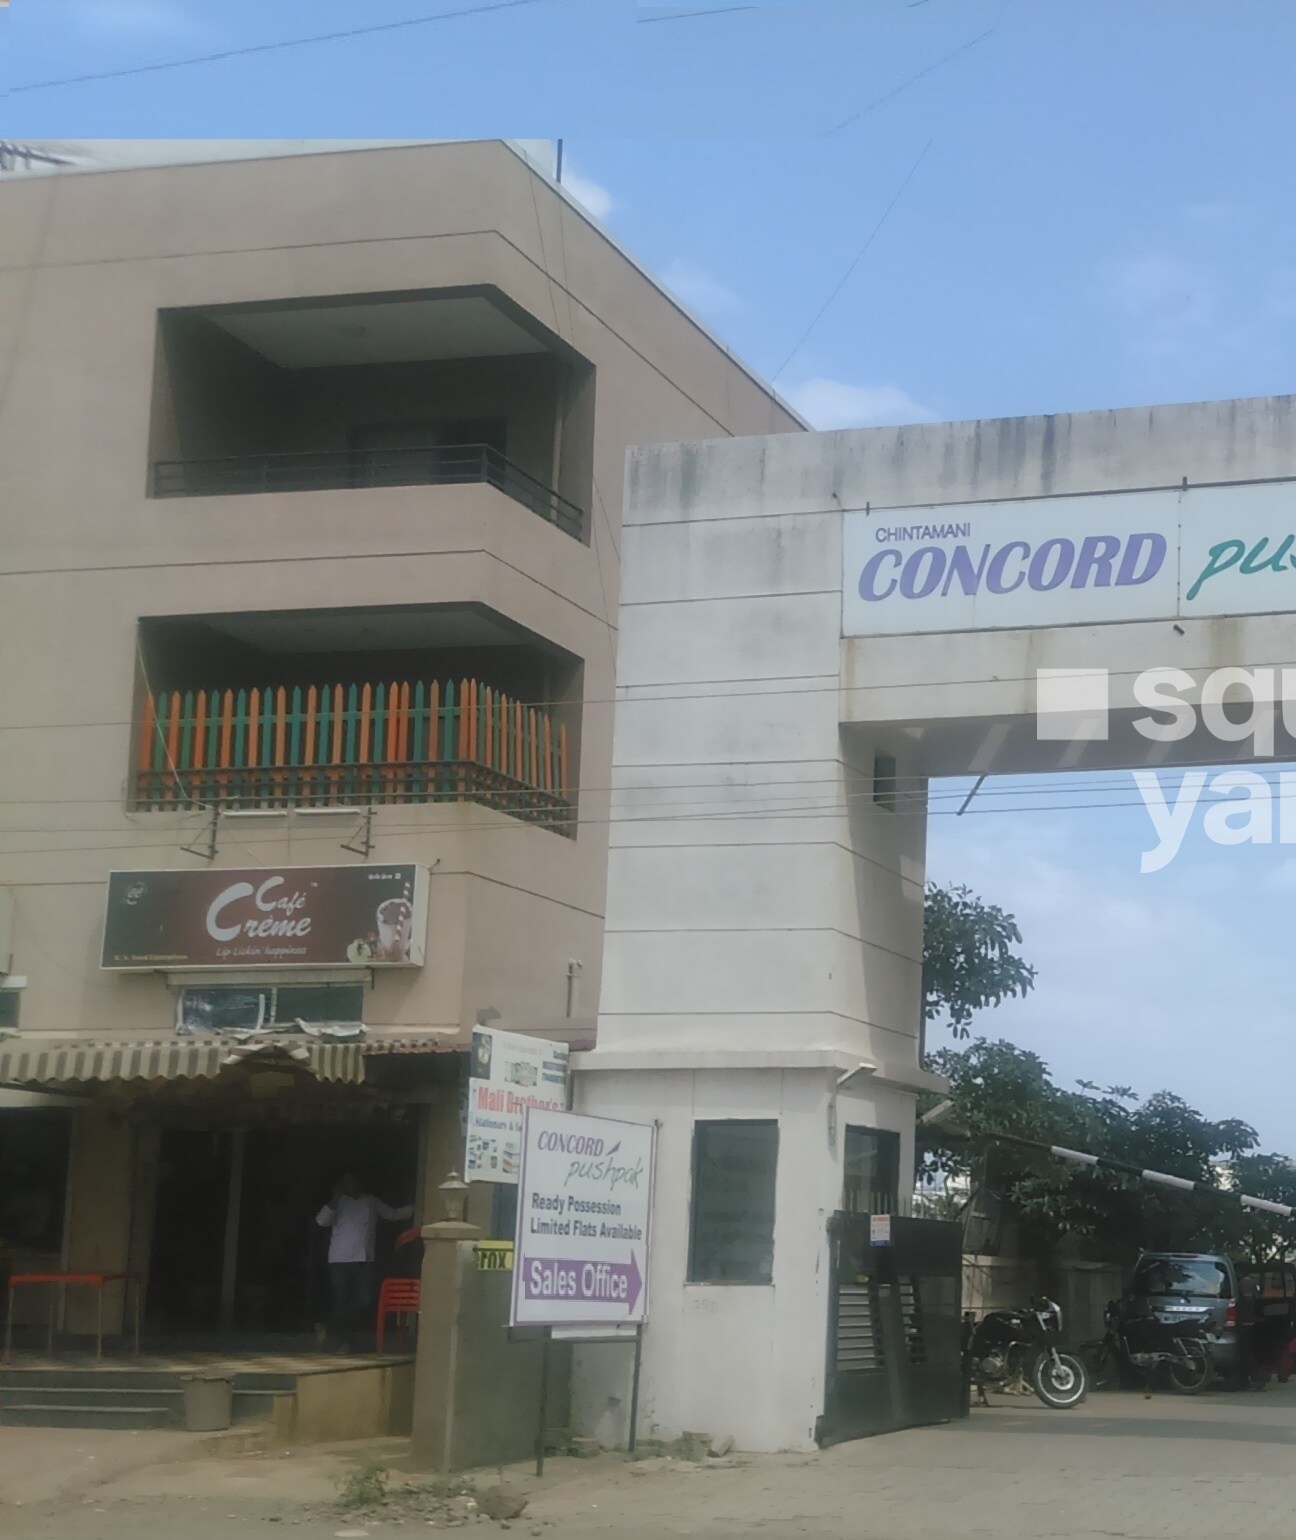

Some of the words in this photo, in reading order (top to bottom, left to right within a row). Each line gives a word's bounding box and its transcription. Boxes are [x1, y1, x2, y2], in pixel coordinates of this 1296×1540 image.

[875, 523, 971, 543] CHINTAMANI
[858, 533, 1167, 602] CONCORD
[256, 876, 307, 916] Café
[206, 882, 312, 942] Crème
[478, 1087, 504, 1112] Mali
[538, 1131, 605, 1157] CONCORD
[564, 1157, 644, 1191] pushpak
[532, 1192, 565, 1215] Ready
[568, 1196, 621, 1216] Possession
[531, 1217, 570, 1236] Limited
[573, 1220, 597, 1237] Flats
[600, 1222, 642, 1240] Available
[530, 1260, 577, 1295] Sales
[581, 1264, 628, 1299] Office
